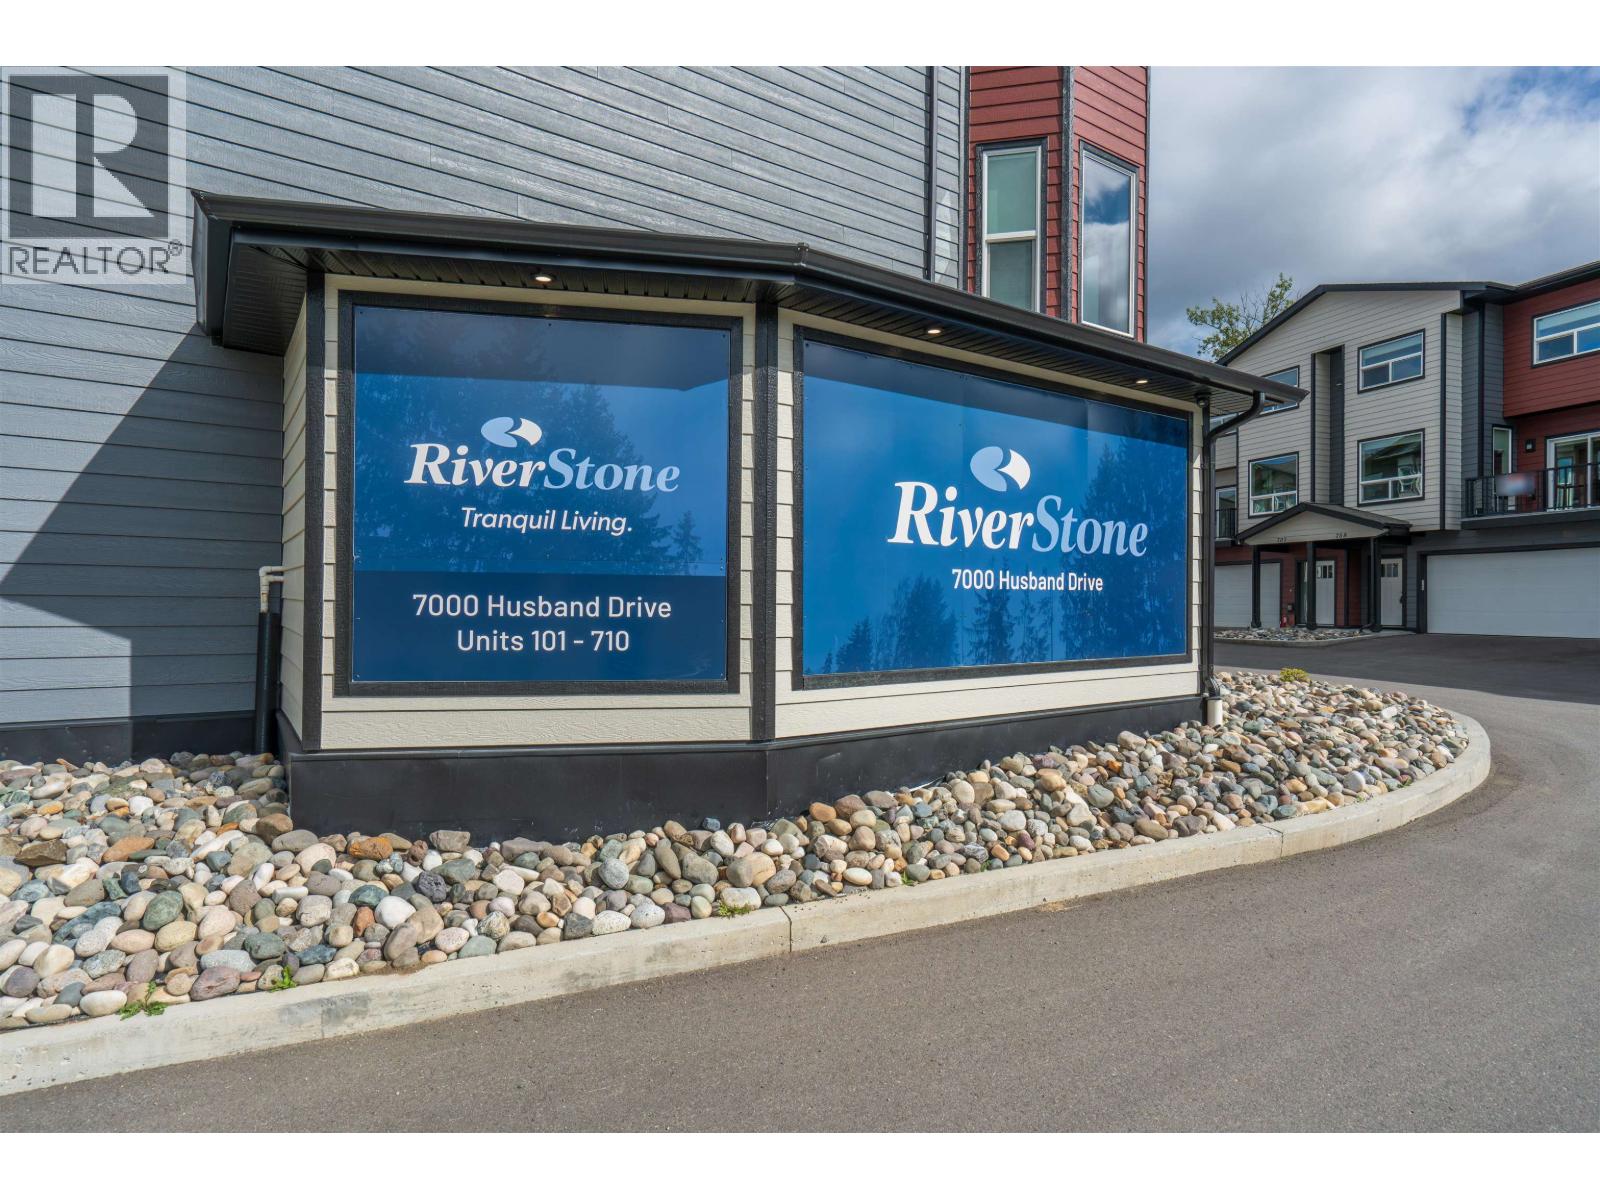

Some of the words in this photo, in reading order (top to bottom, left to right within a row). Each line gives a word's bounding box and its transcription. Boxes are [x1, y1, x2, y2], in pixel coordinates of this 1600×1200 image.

[403, 443, 681, 492] RiverStone
[461, 507, 556, 534] Tranquil
[561, 510, 633, 537] Living.
[887, 481, 1149, 557] RiverStone
[952, 568, 995, 590] 7000
[999, 570, 1065, 592] Husband
[1068, 572, 1104, 592] Drive
[412, 594, 479, 617] 7000
[488, 595, 600, 618] Husband
[608, 596, 672, 618] Drive
[457, 629, 524, 651] Units
[531, 630, 566, 652] 101
[590, 630, 630, 652] 710
